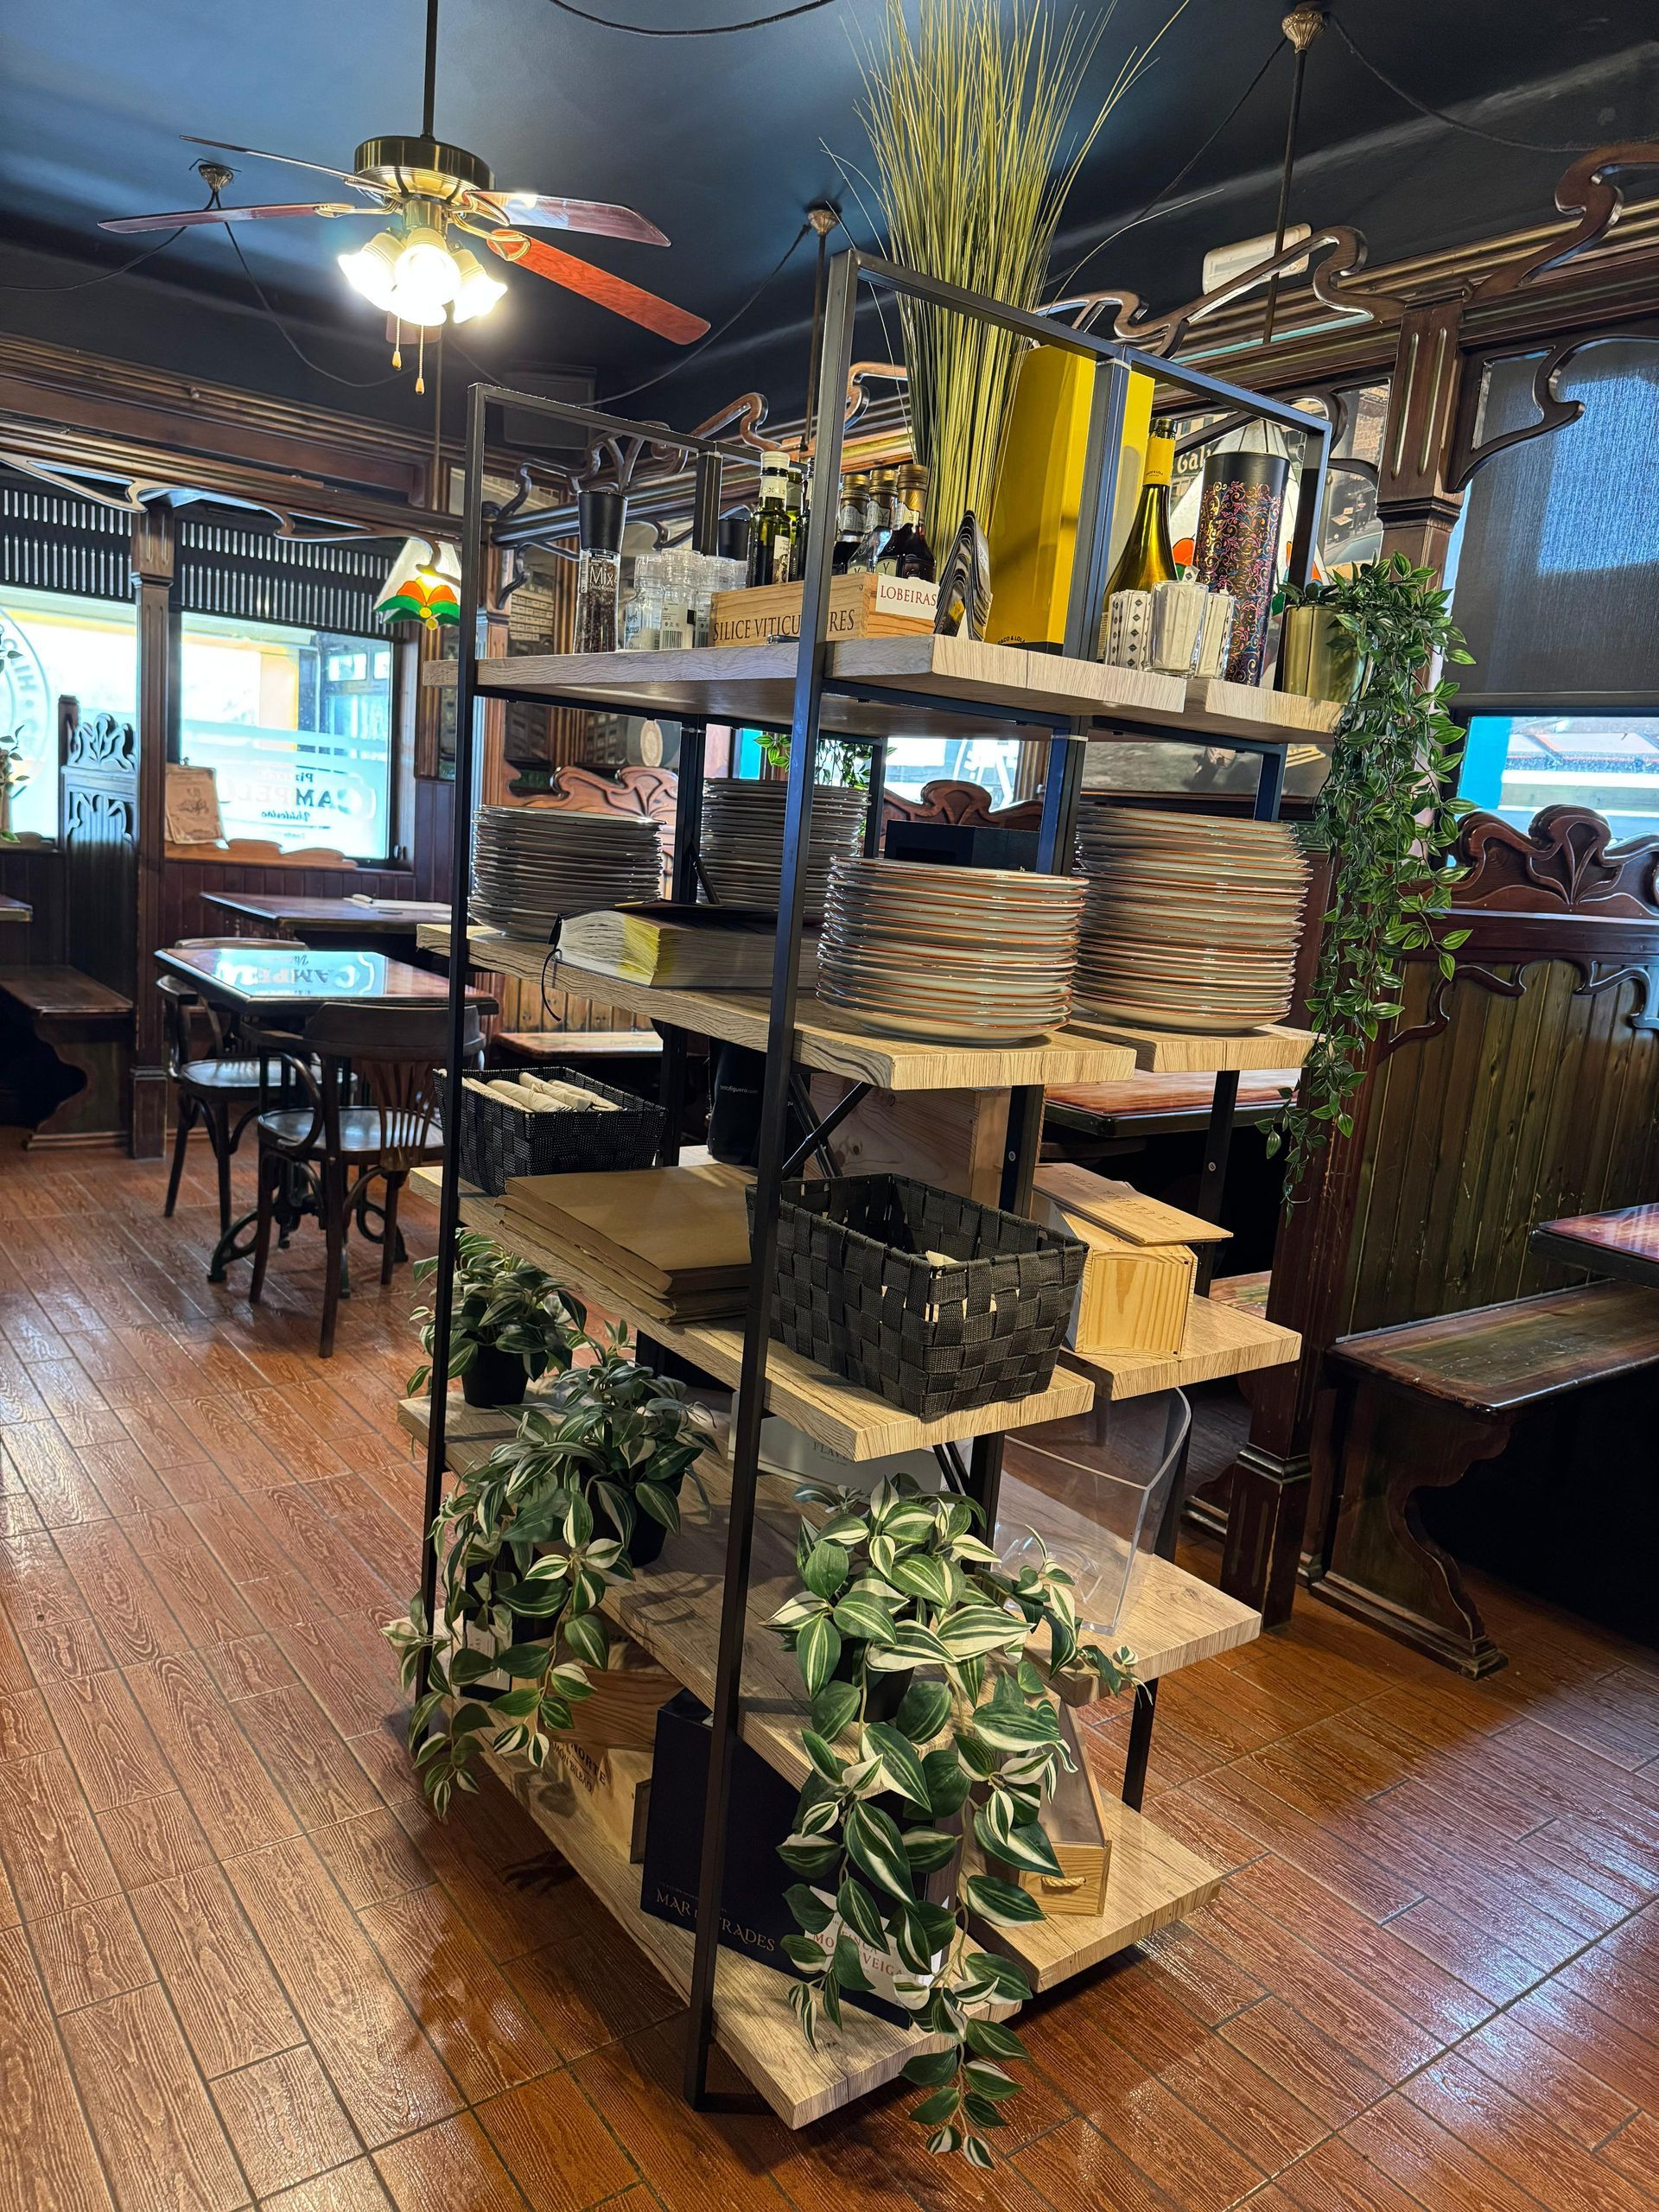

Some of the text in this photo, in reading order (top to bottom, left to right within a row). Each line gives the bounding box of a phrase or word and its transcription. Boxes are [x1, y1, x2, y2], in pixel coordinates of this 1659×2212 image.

[1177, 445, 1211, 474] Gal
[590, 566, 614, 588] Mix
[880, 585, 938, 607] LOBEIRAS
[713, 608, 855, 642] SILICE VITICURES
[657, 1888, 690, 1916] MAR
[720, 1916, 775, 1952] RADES
